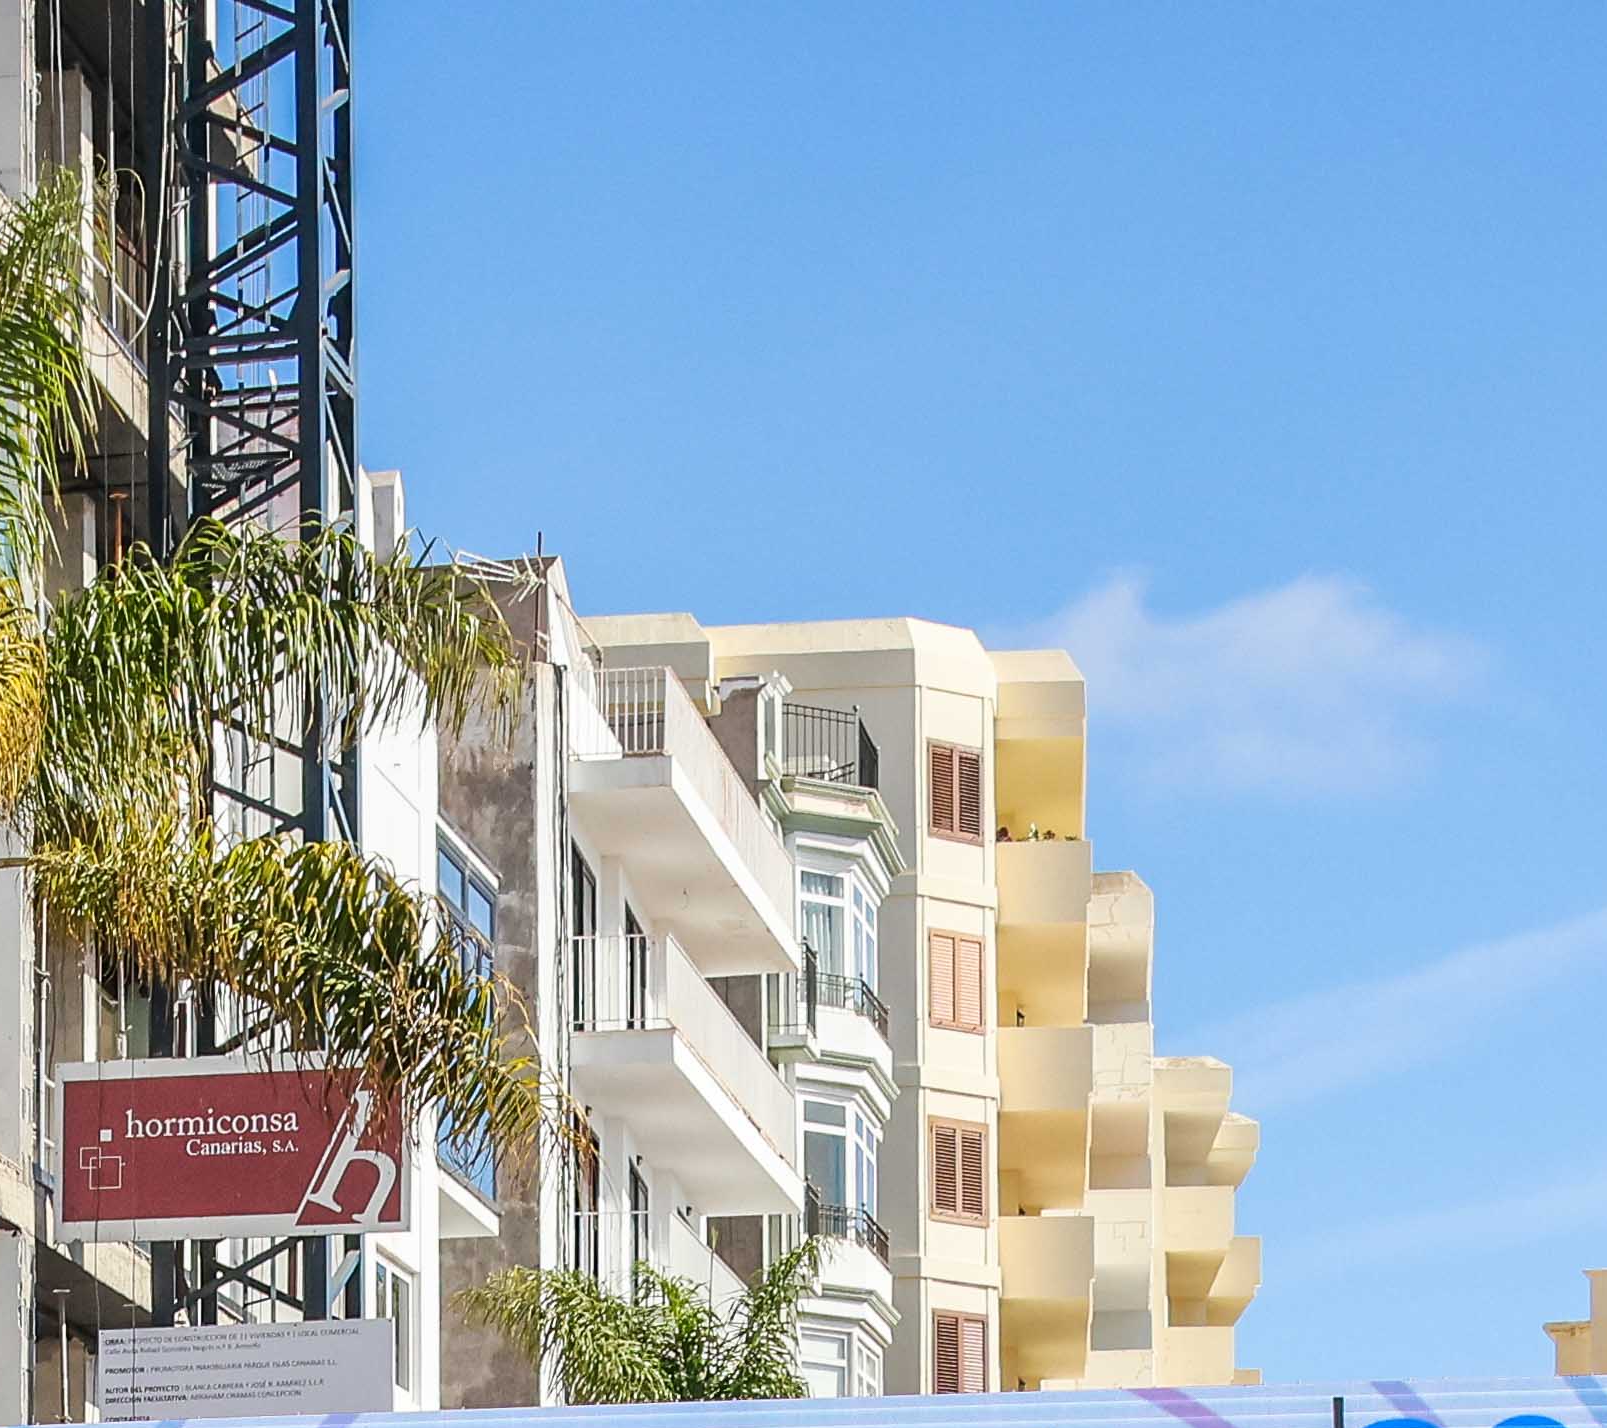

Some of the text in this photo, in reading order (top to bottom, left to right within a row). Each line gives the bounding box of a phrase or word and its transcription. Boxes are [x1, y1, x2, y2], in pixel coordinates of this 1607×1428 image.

[124, 1108, 299, 1139] hormiconsa
[185, 1138, 299, 1157] Canarias, S.A.
